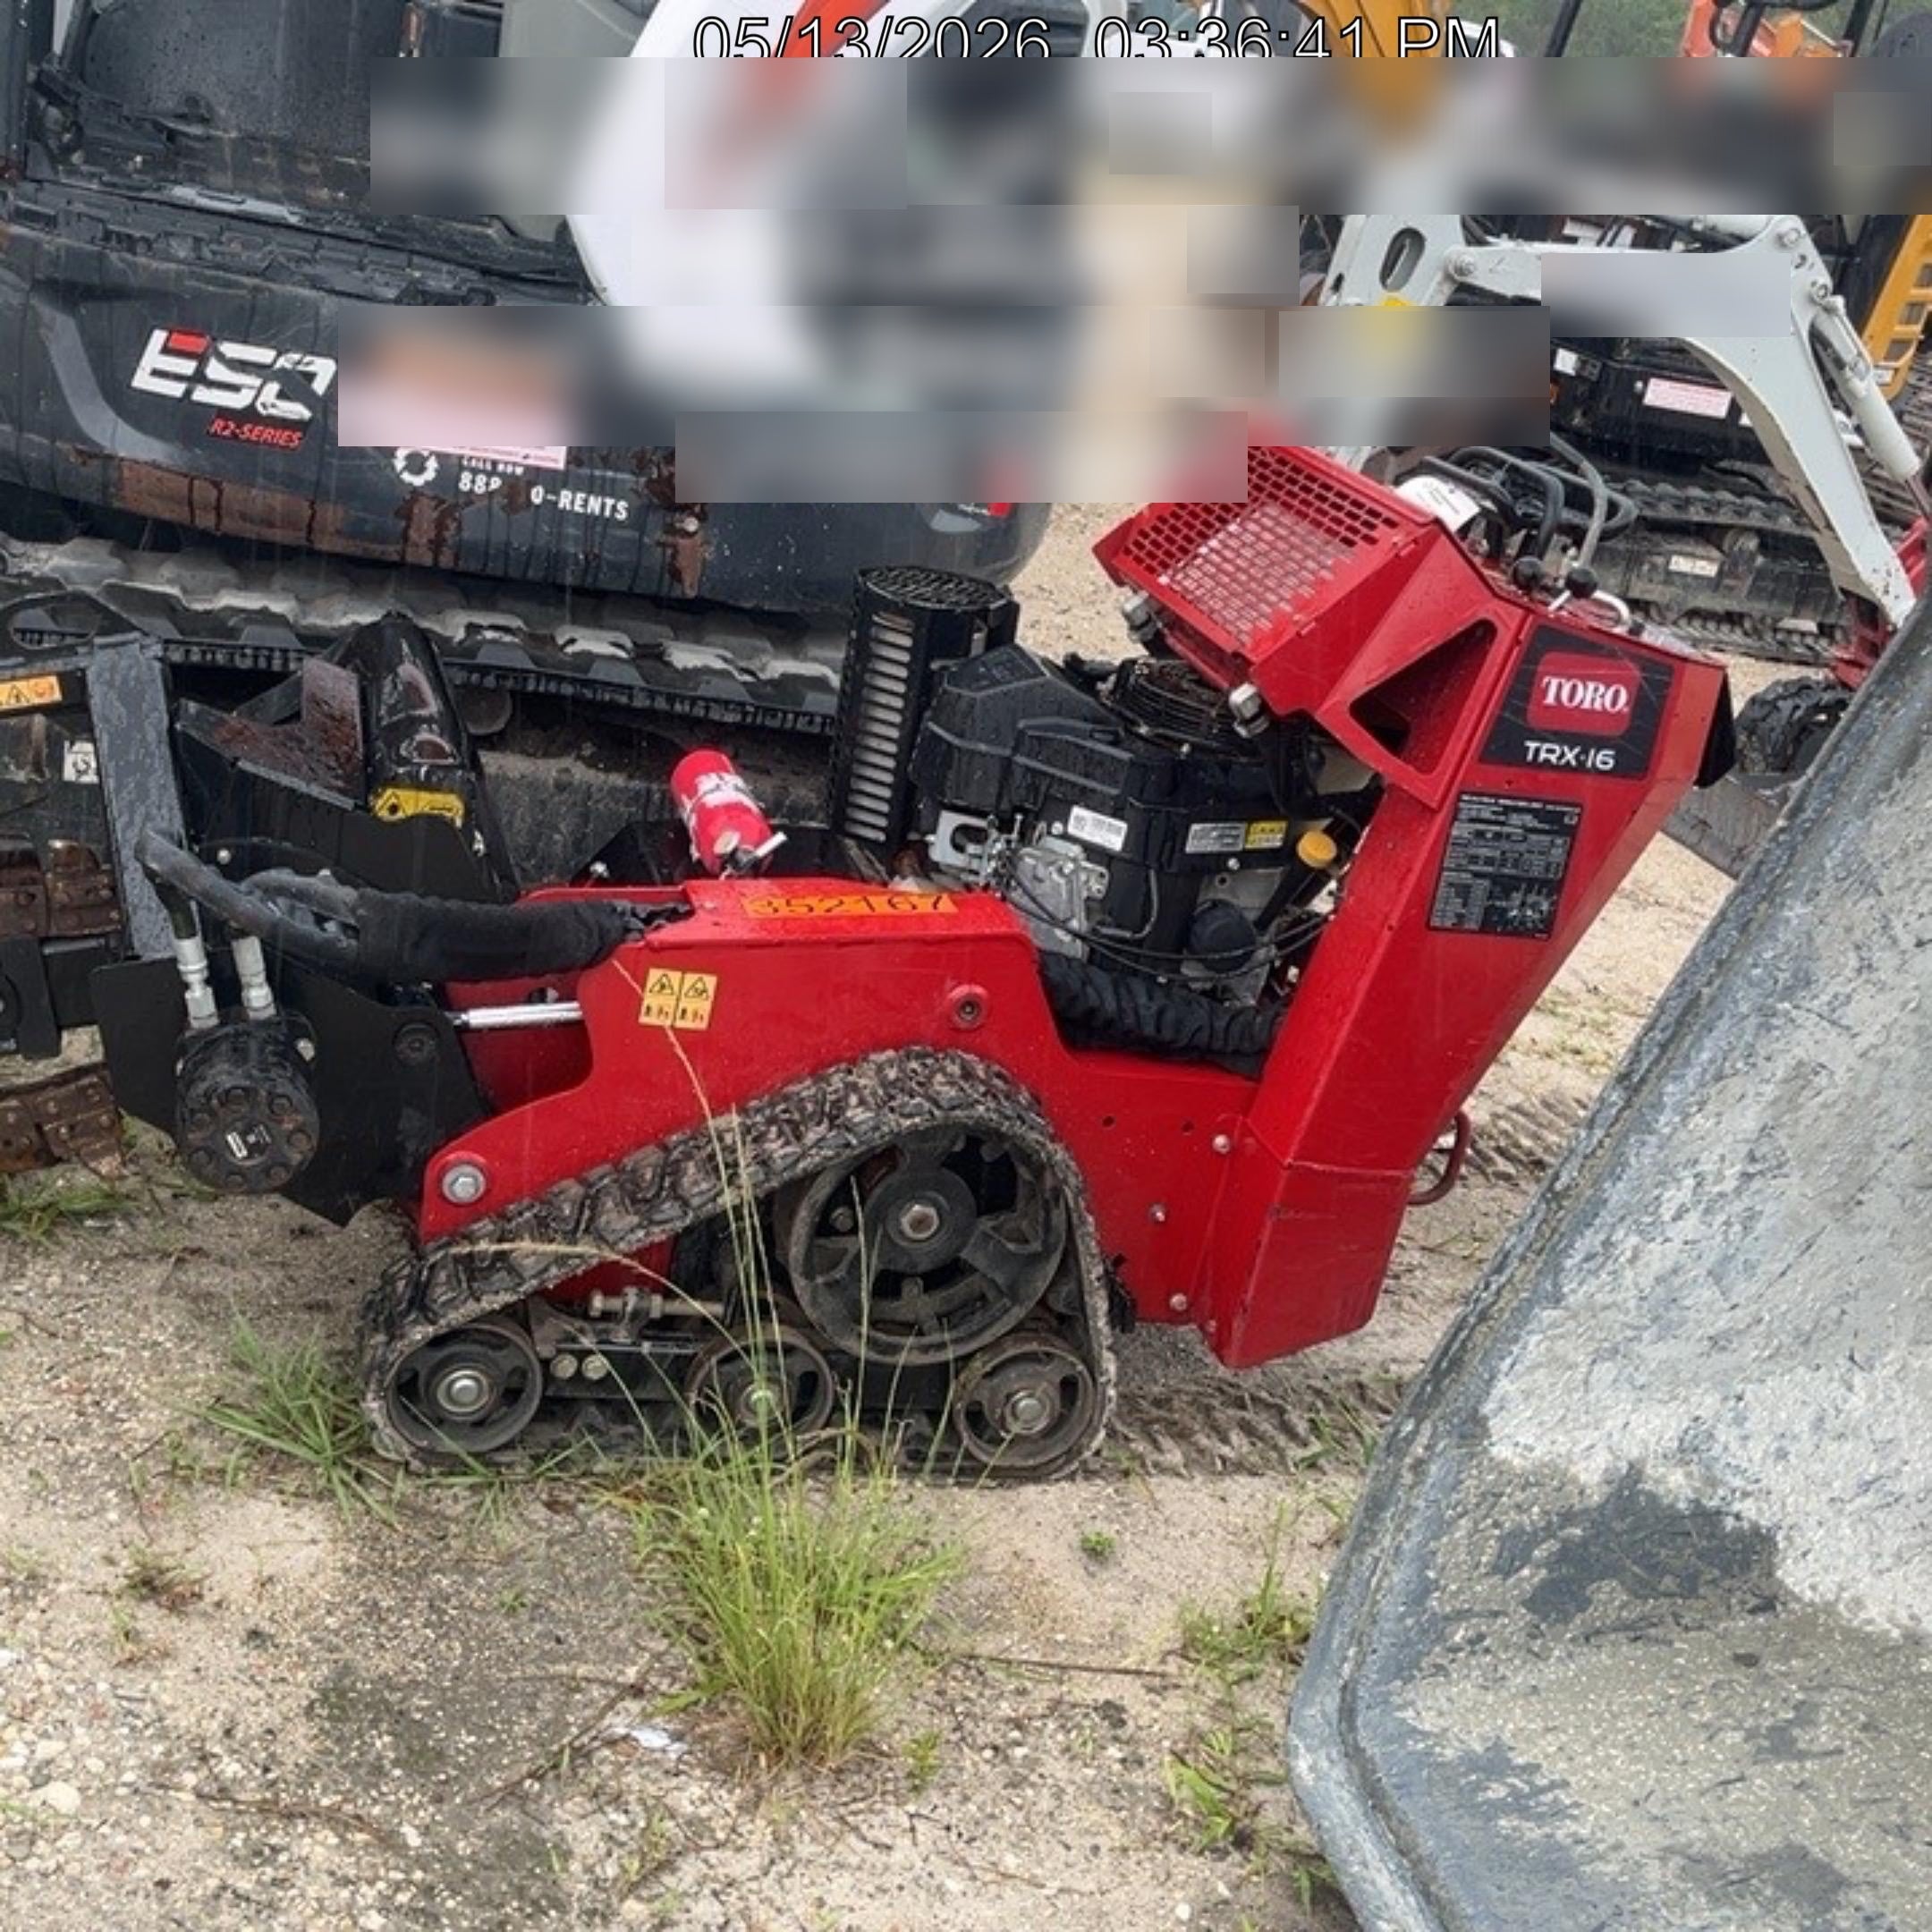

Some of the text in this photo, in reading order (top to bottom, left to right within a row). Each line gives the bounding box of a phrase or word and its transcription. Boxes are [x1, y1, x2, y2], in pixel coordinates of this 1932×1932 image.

[209, 418, 303, 446] R2-SERIES
[1540, 675, 1629, 713] TORO
[1523, 740, 1616, 771] TRX-16
